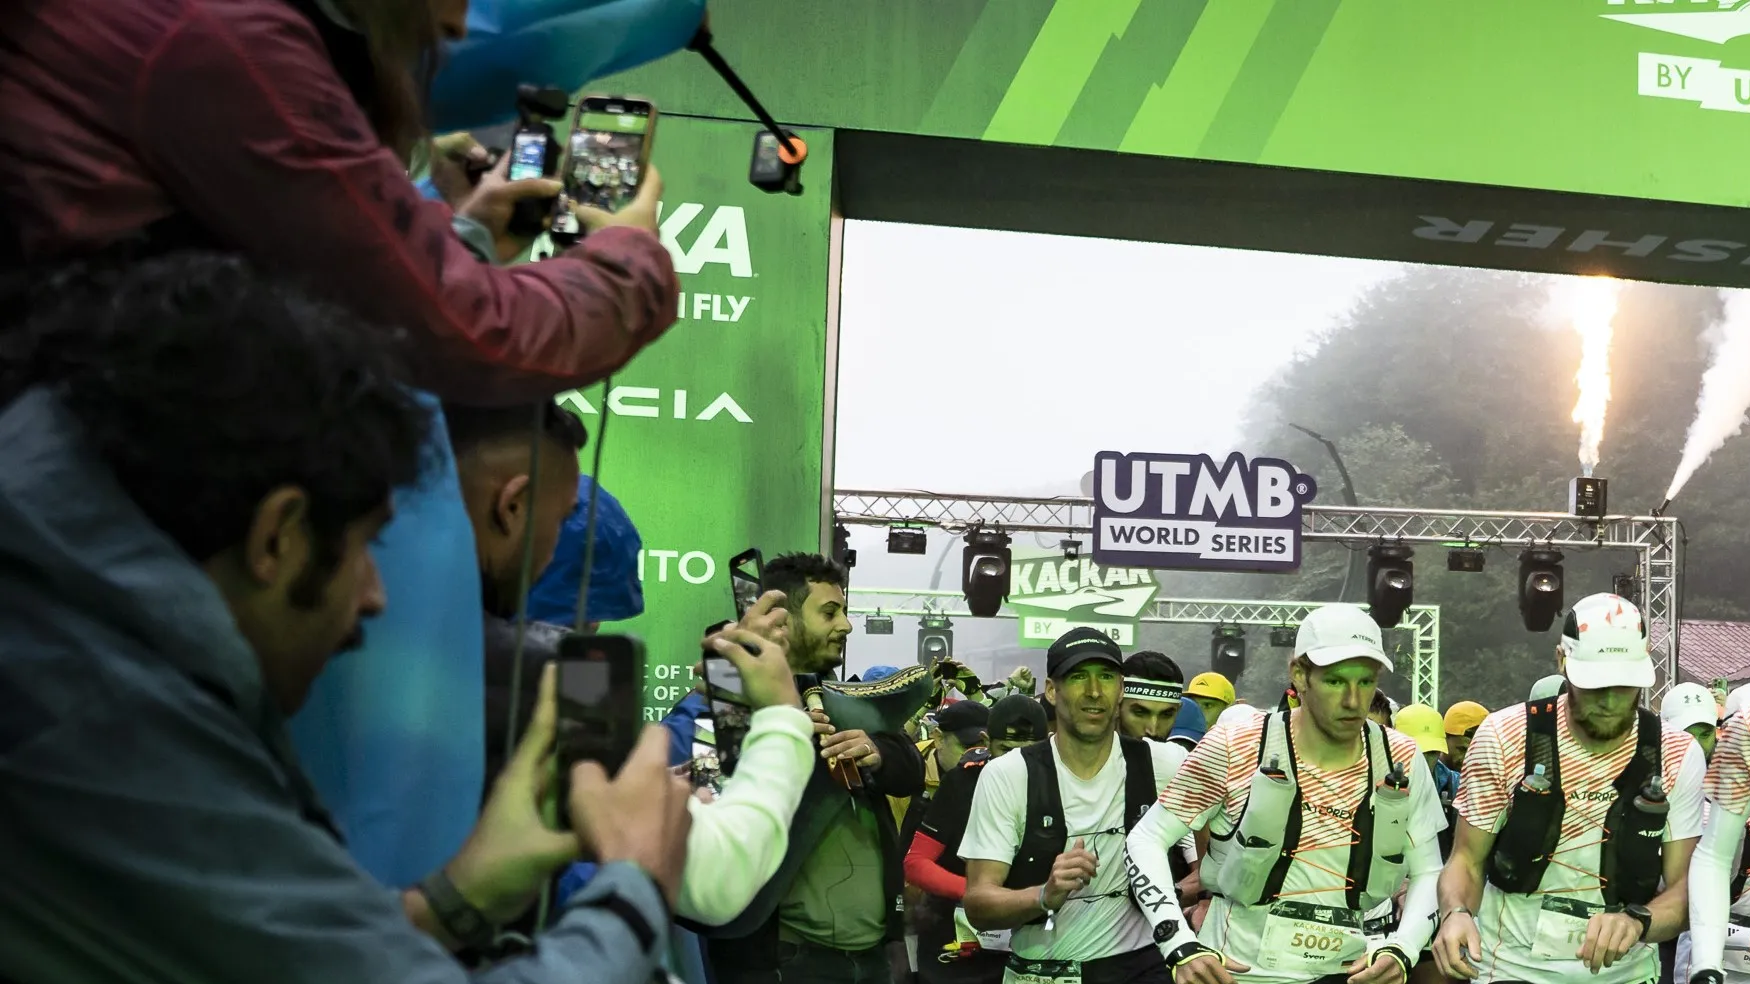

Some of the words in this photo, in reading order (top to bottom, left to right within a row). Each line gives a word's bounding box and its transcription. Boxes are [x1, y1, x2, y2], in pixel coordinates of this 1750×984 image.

[1657, 62, 1693, 90] BY
[654, 201, 753, 278] KA
[693, 293, 750, 322] FLY
[554, 385, 754, 424] ACIA
[1101, 458, 1295, 520] UTMB
[1110, 525, 1200, 547] WORLD
[1211, 534, 1287, 555] SERIES
[1034, 621, 1053, 635] BY
[654, 665, 680, 680] OF
[654, 686, 680, 701] OF
[1581, 790, 1618, 802] TERRE
[1290, 933, 1344, 953] 5002
[1302, 952, 1326, 961] Sven
